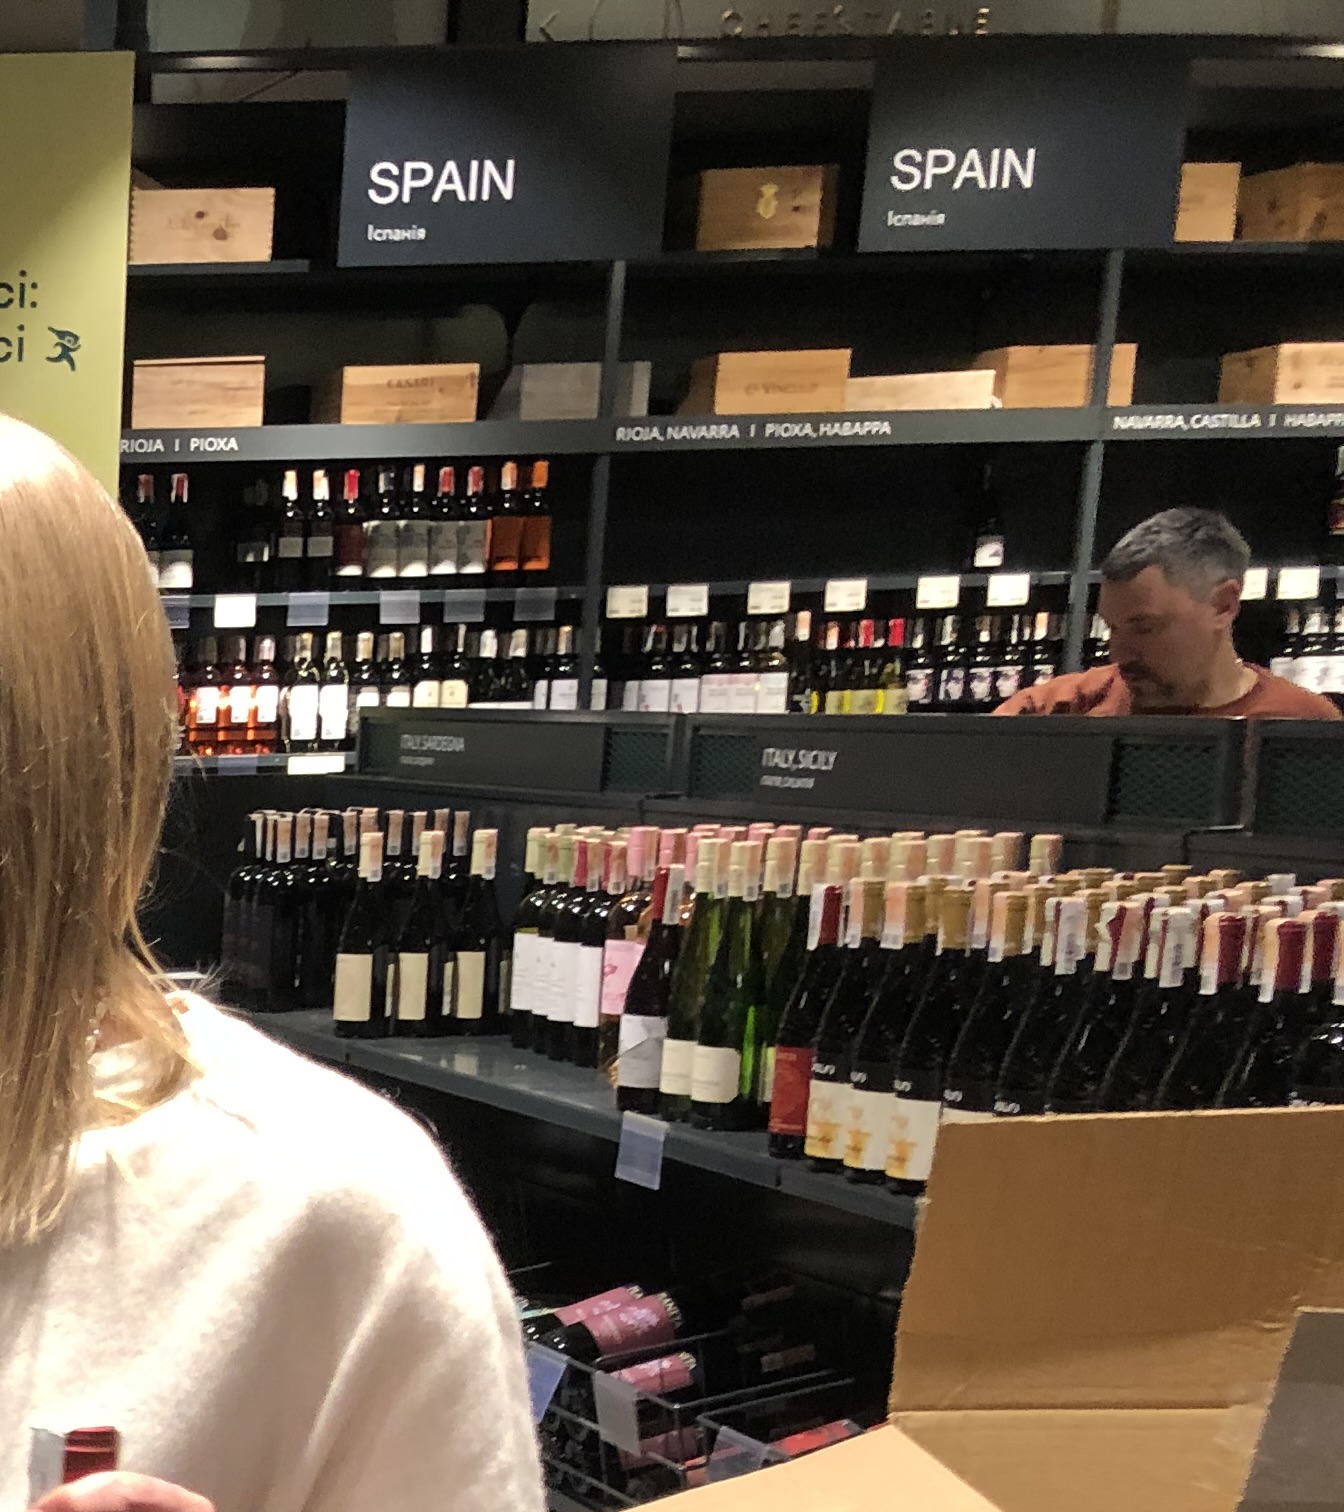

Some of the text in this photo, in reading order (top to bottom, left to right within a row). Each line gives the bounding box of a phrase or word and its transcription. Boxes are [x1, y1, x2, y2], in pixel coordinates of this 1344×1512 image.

[368, 160, 514, 204] SPAIN
[891, 148, 1035, 190] SPAIN
[368, 225, 425, 241] Іспанія
[119, 438, 164, 453] RIOJA
